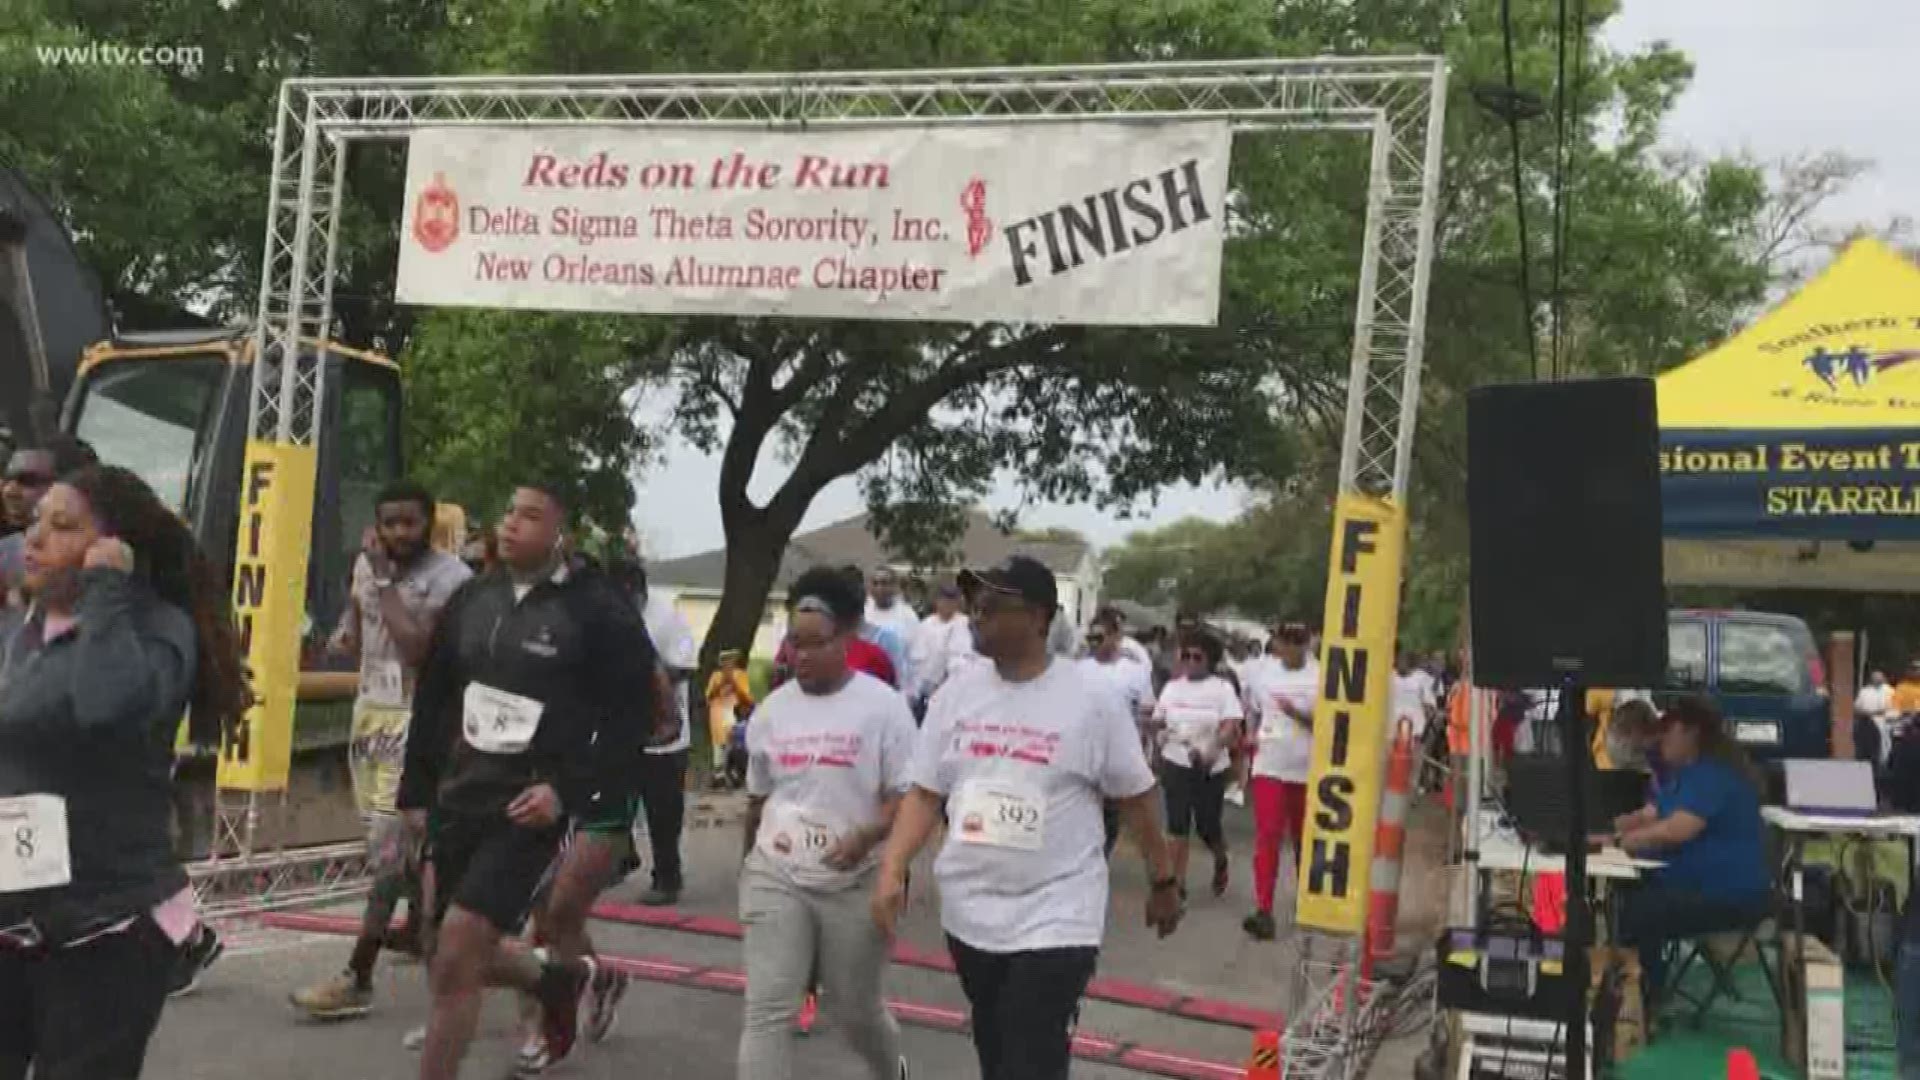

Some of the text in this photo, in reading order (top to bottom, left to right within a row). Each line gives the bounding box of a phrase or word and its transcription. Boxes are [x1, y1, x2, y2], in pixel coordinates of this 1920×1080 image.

[524, 152, 891, 190] Reds on the Run
[469, 206, 950, 248] Delta Sigma Theta Sorority, Inc.
[1003, 158, 1212, 288] FINISH
[475, 252, 947, 298] New Orleans Alumnae Chapter
[1779, 443, 1892, 472] Event
[1308, 518, 1379, 899] FINISH
